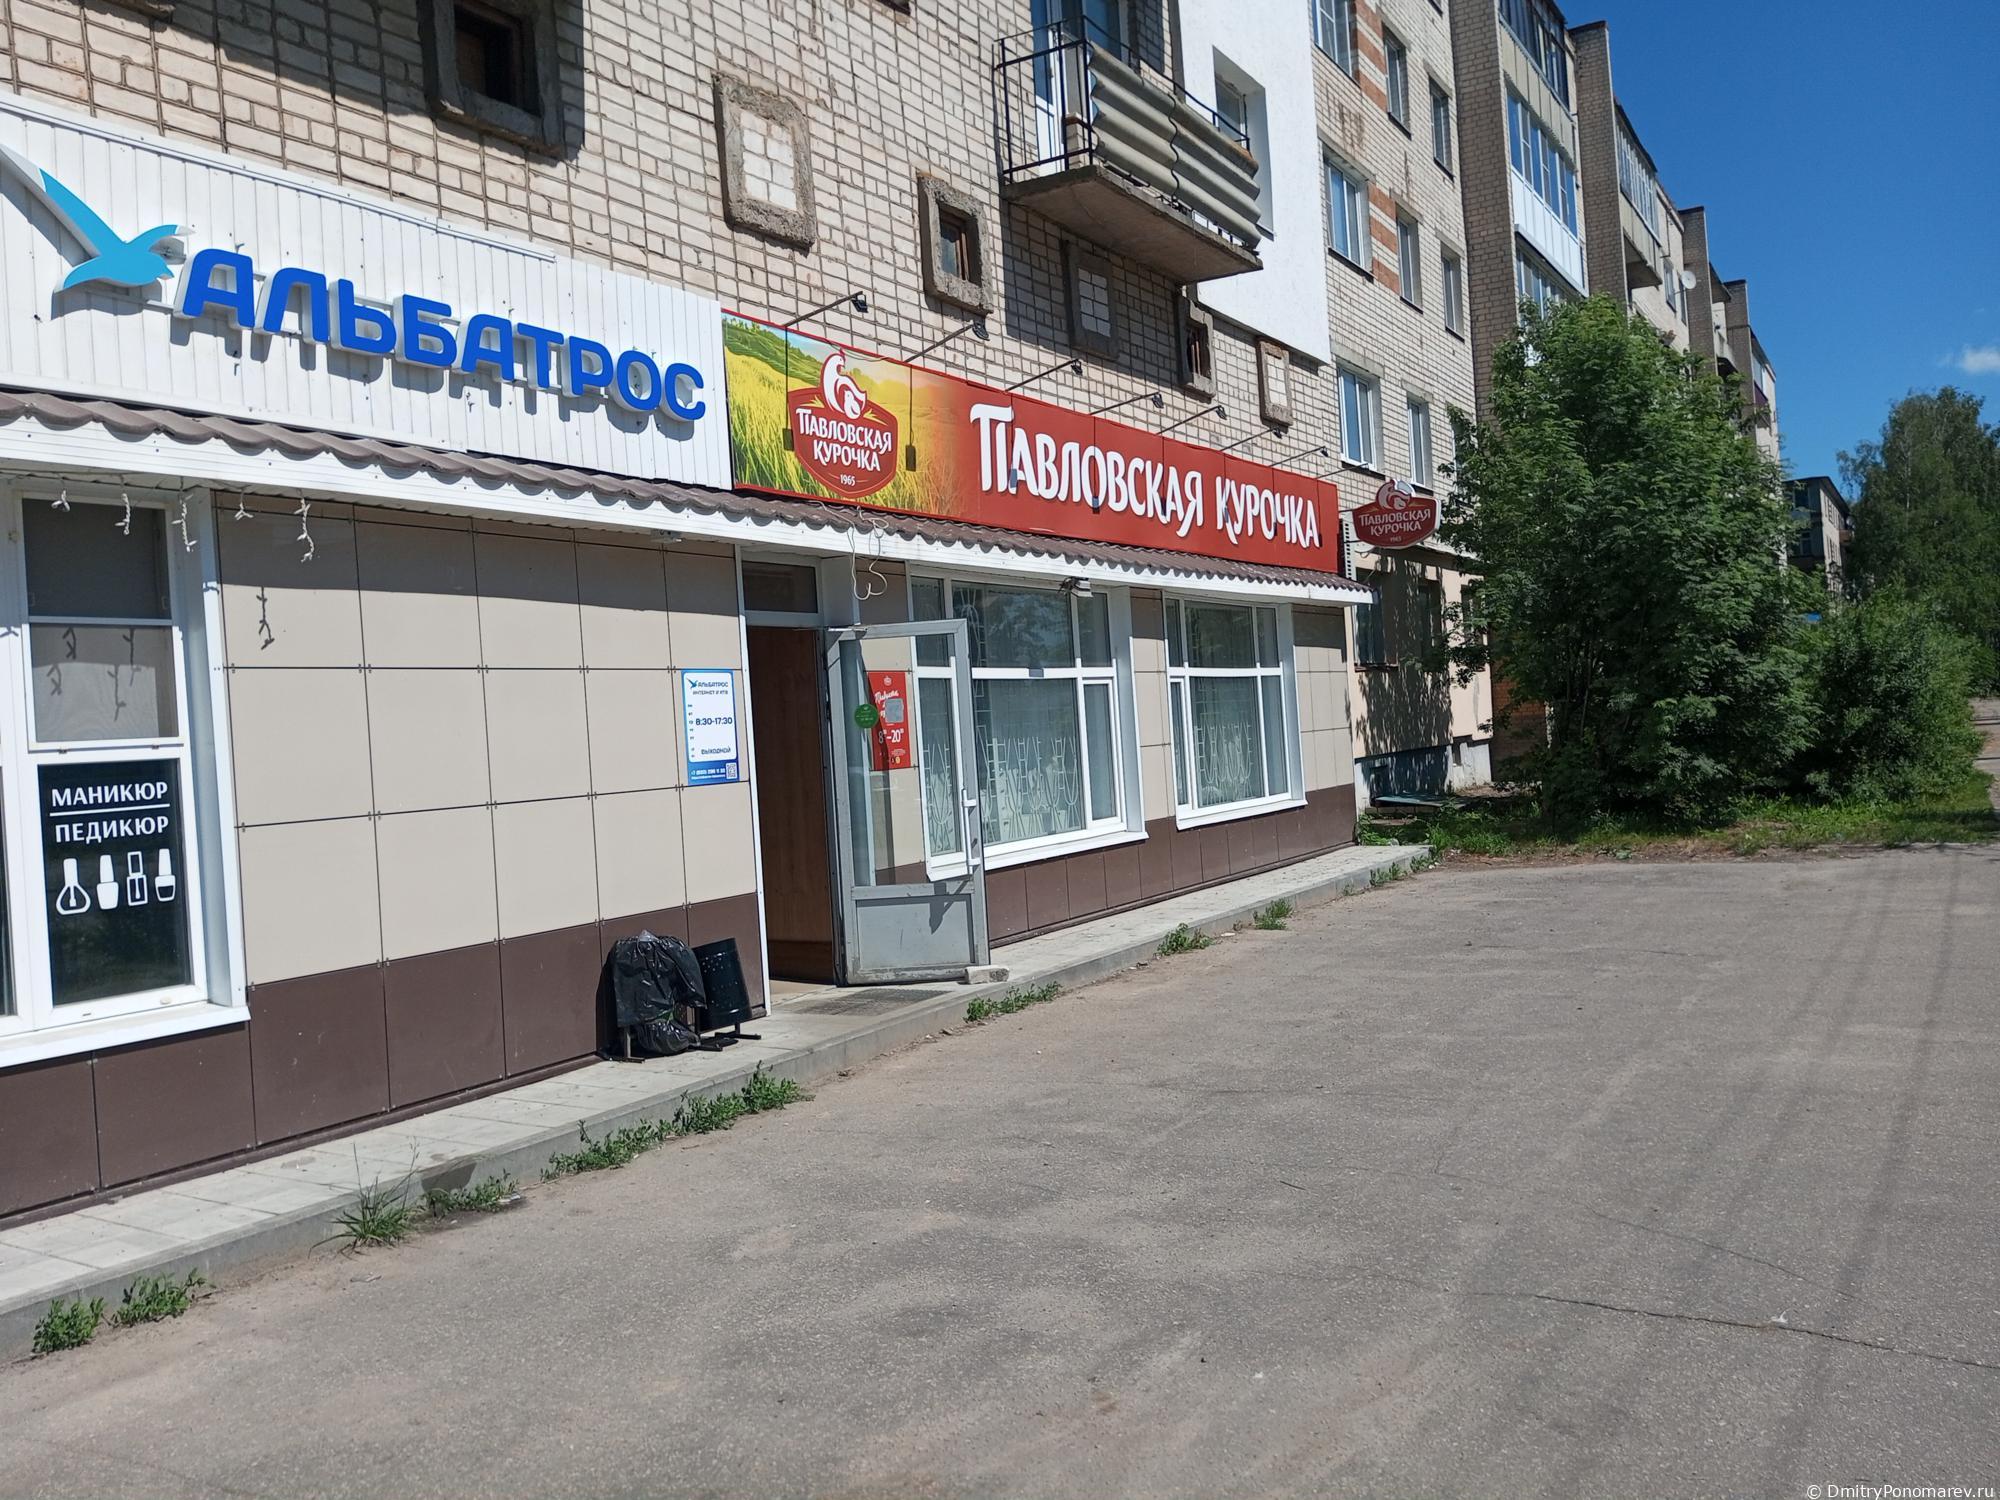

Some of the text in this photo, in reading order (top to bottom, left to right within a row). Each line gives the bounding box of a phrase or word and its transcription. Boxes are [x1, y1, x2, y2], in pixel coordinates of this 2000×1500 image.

[176, 247, 706, 421] АЛЬБАТРОС
[795, 408, 892, 455] ПАВЛОВСКАЯ
[813, 440, 881, 472] КУРОЧКА
[839, 474, 856, 487] 1965
[970, 403, 1321, 549] ПАВЛОВСКАЯ КУРОЧКА
[1359, 509, 1430, 526] ПАВЛОВСКАЯ
[1371, 521, 1421, 536] КУРОЧКА
[695, 717, 733, 726] 8:30-17:30
[701, 746, 731, 755] ВЫХОДНОЙ
[51, 781, 168, 807] МАНИКЮР
[55, 815, 169, 844] ПЕДИКЮР
